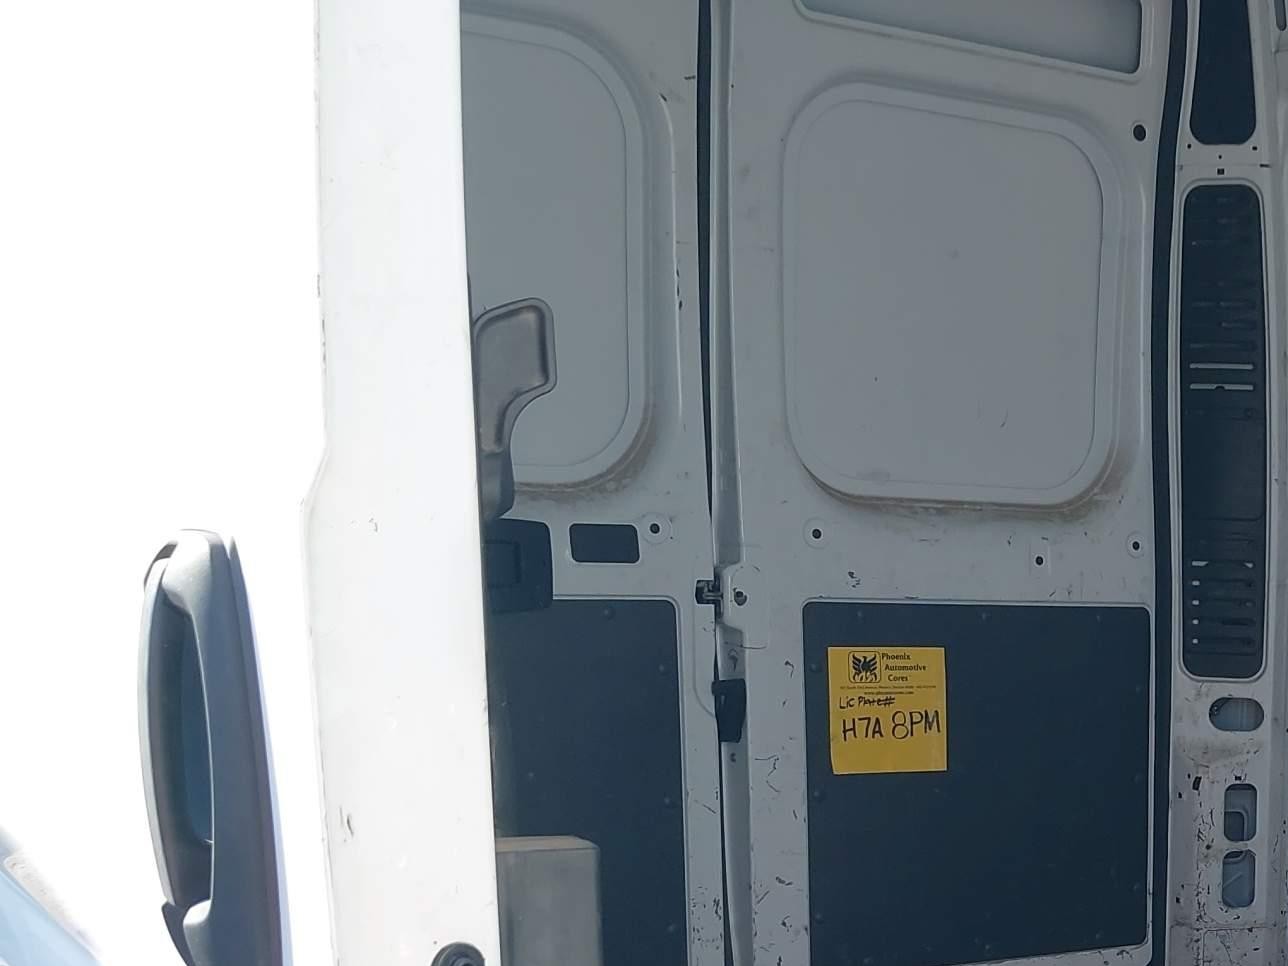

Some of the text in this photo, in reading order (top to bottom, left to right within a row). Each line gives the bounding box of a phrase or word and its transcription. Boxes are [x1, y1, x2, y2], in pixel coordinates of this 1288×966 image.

[881, 652, 911, 661] Phoenix
[884, 663, 927, 671] Automotive
[887, 674, 908, 682] Cores
